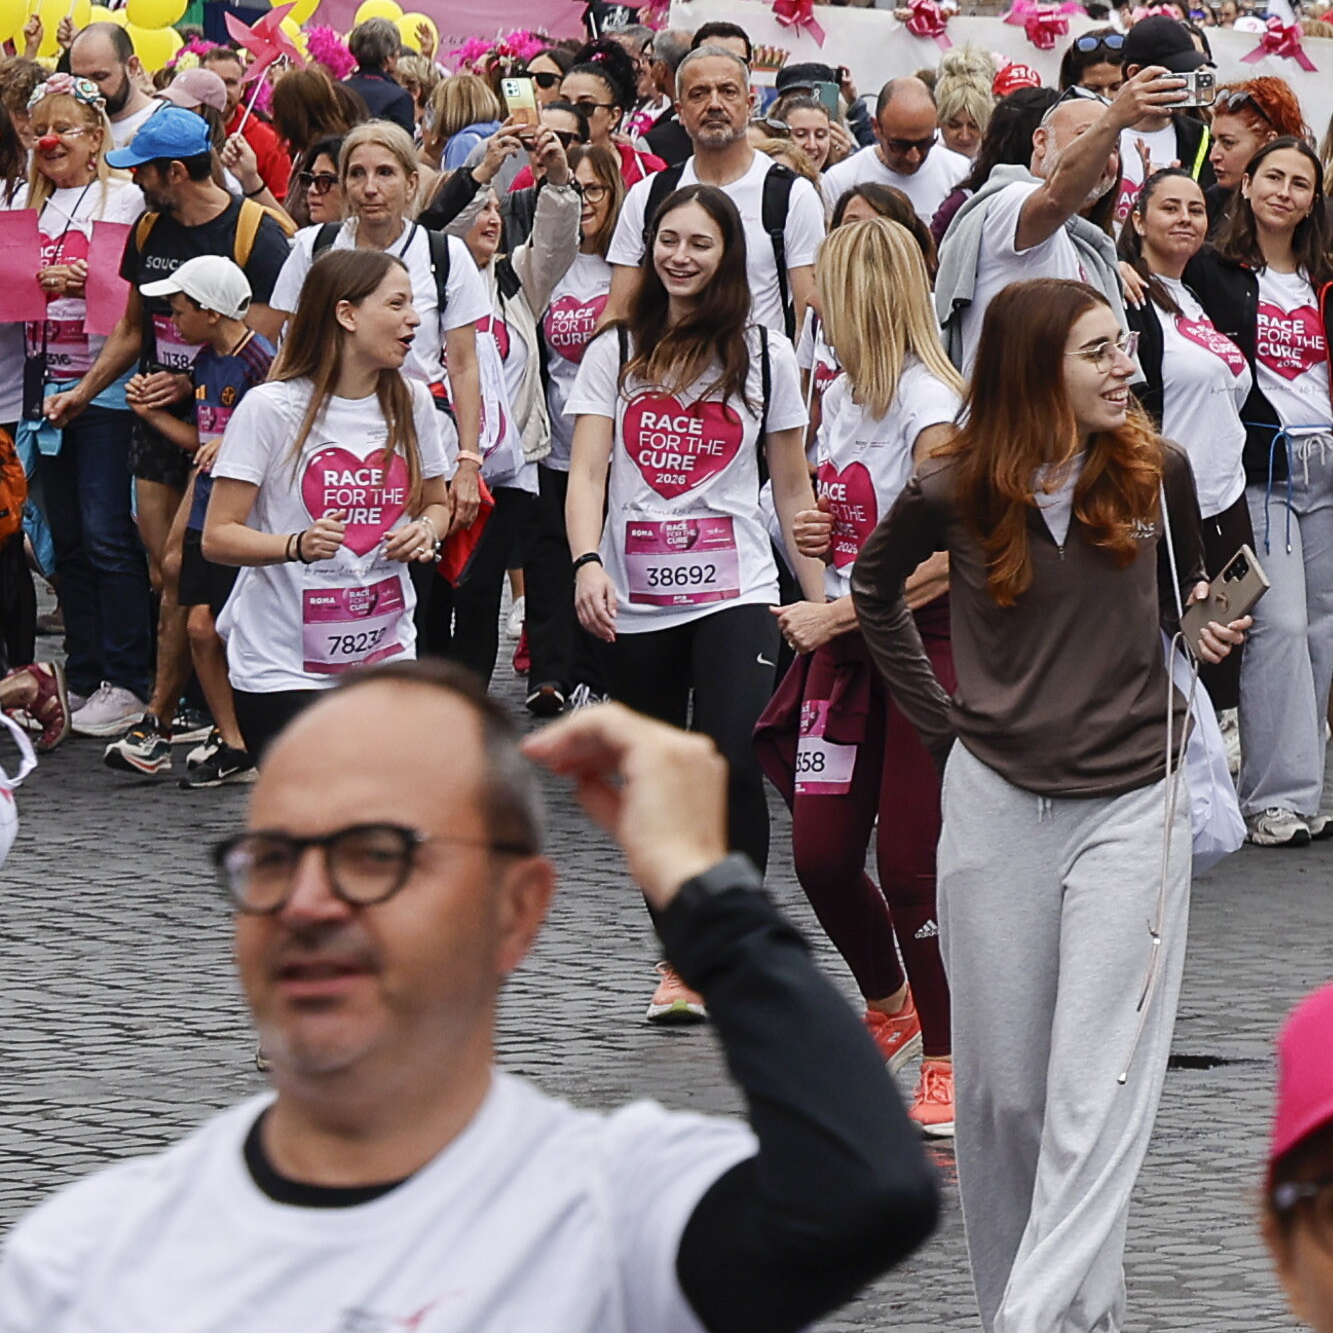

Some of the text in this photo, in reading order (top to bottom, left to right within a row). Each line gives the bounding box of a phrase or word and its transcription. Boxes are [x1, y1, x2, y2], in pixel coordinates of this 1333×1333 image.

[552, 306, 595, 320] RACE
[551, 320, 578, 333] FOR
[1257, 314, 1305, 334] RACE
[1257, 327, 1325, 351] FOR THE
[1257, 342, 1304, 359] CURE
[640, 411, 704, 435] RACE
[638, 431, 726, 456] FOR THE
[638, 450, 697, 471] CURE
[323, 469, 384, 487] RACE
[655, 473, 686, 485] 2026
[323, 487, 404, 507] FOR THE
[631, 529, 654, 537] ROMA
[666, 523, 688, 531] RACE
[666, 537, 688, 545] CURE
[646, 564, 717, 587] 38692
[310, 597, 336, 605] ROMA
